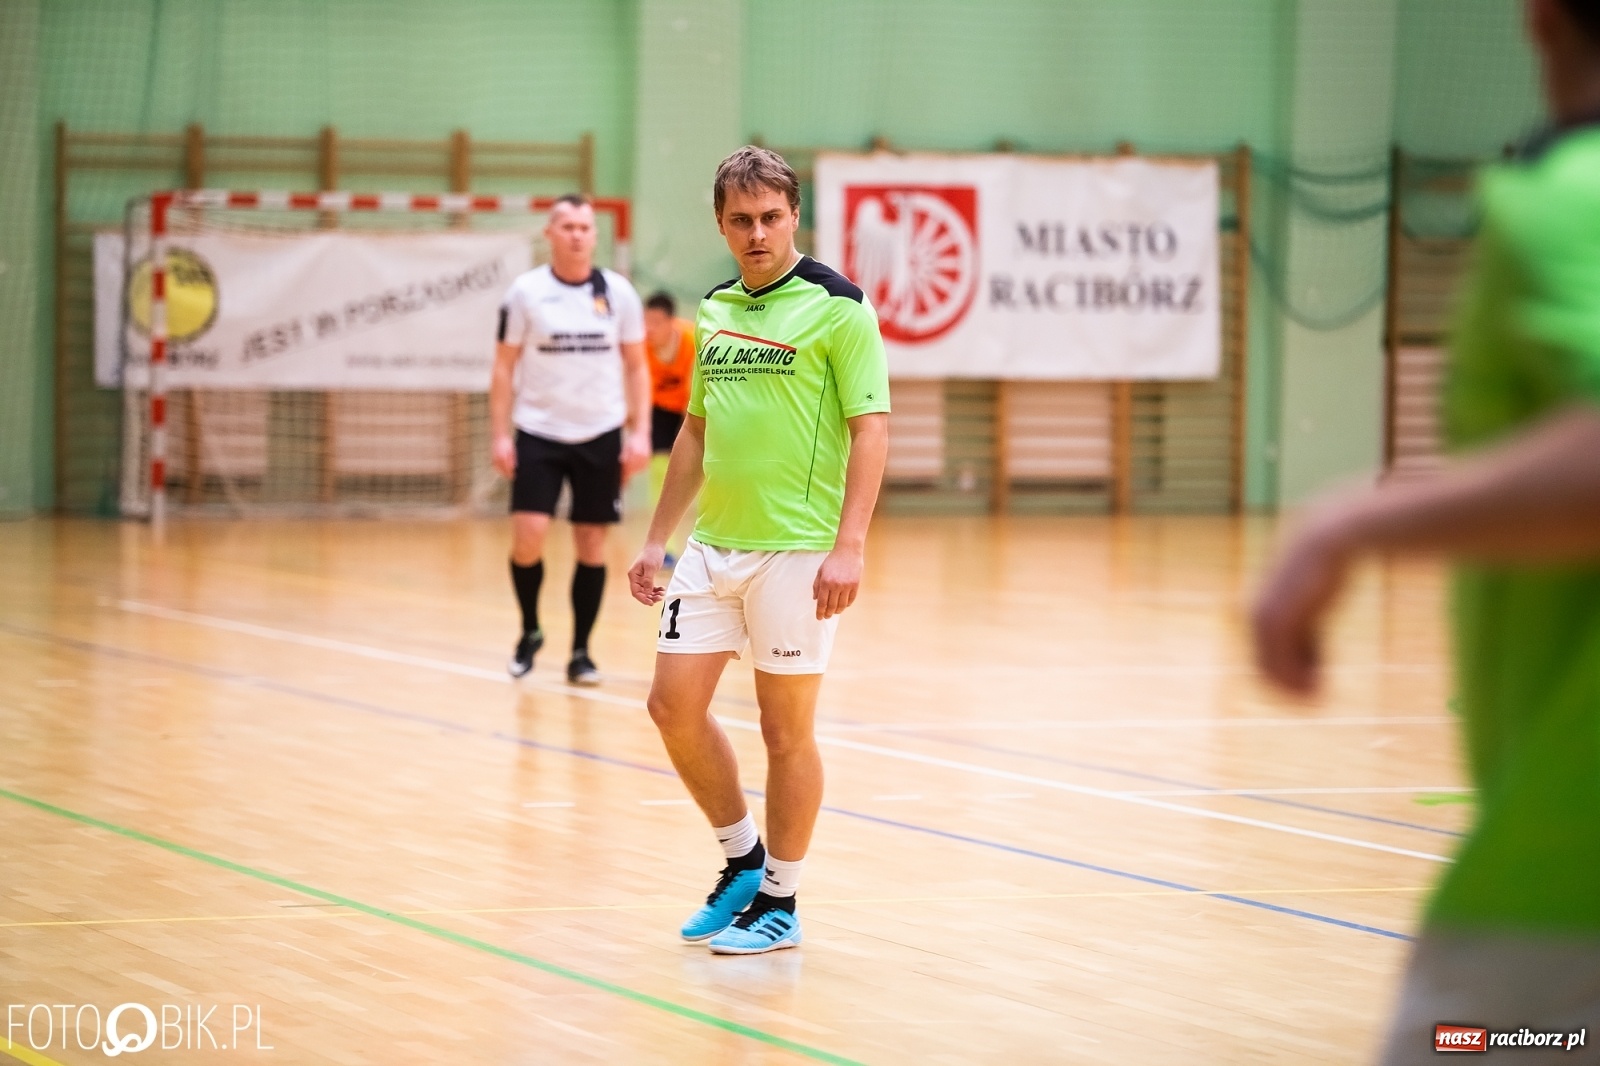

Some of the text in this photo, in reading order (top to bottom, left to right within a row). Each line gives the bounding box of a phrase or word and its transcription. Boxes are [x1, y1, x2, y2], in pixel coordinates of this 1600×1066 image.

[1015, 220, 1178, 259] MIASTO
[988, 268, 1204, 312] RACIBÓRZ
[745, 304, 766, 312] JAKO
[239, 317, 304, 364] JEST
[699, 345, 797, 366] .M.J. DACHMIG
[711, 367, 796, 376] DEKARSKO-CIESIELSKIE
[658, 598, 681, 640] 1
[782, 650, 801, 658] JAKO
